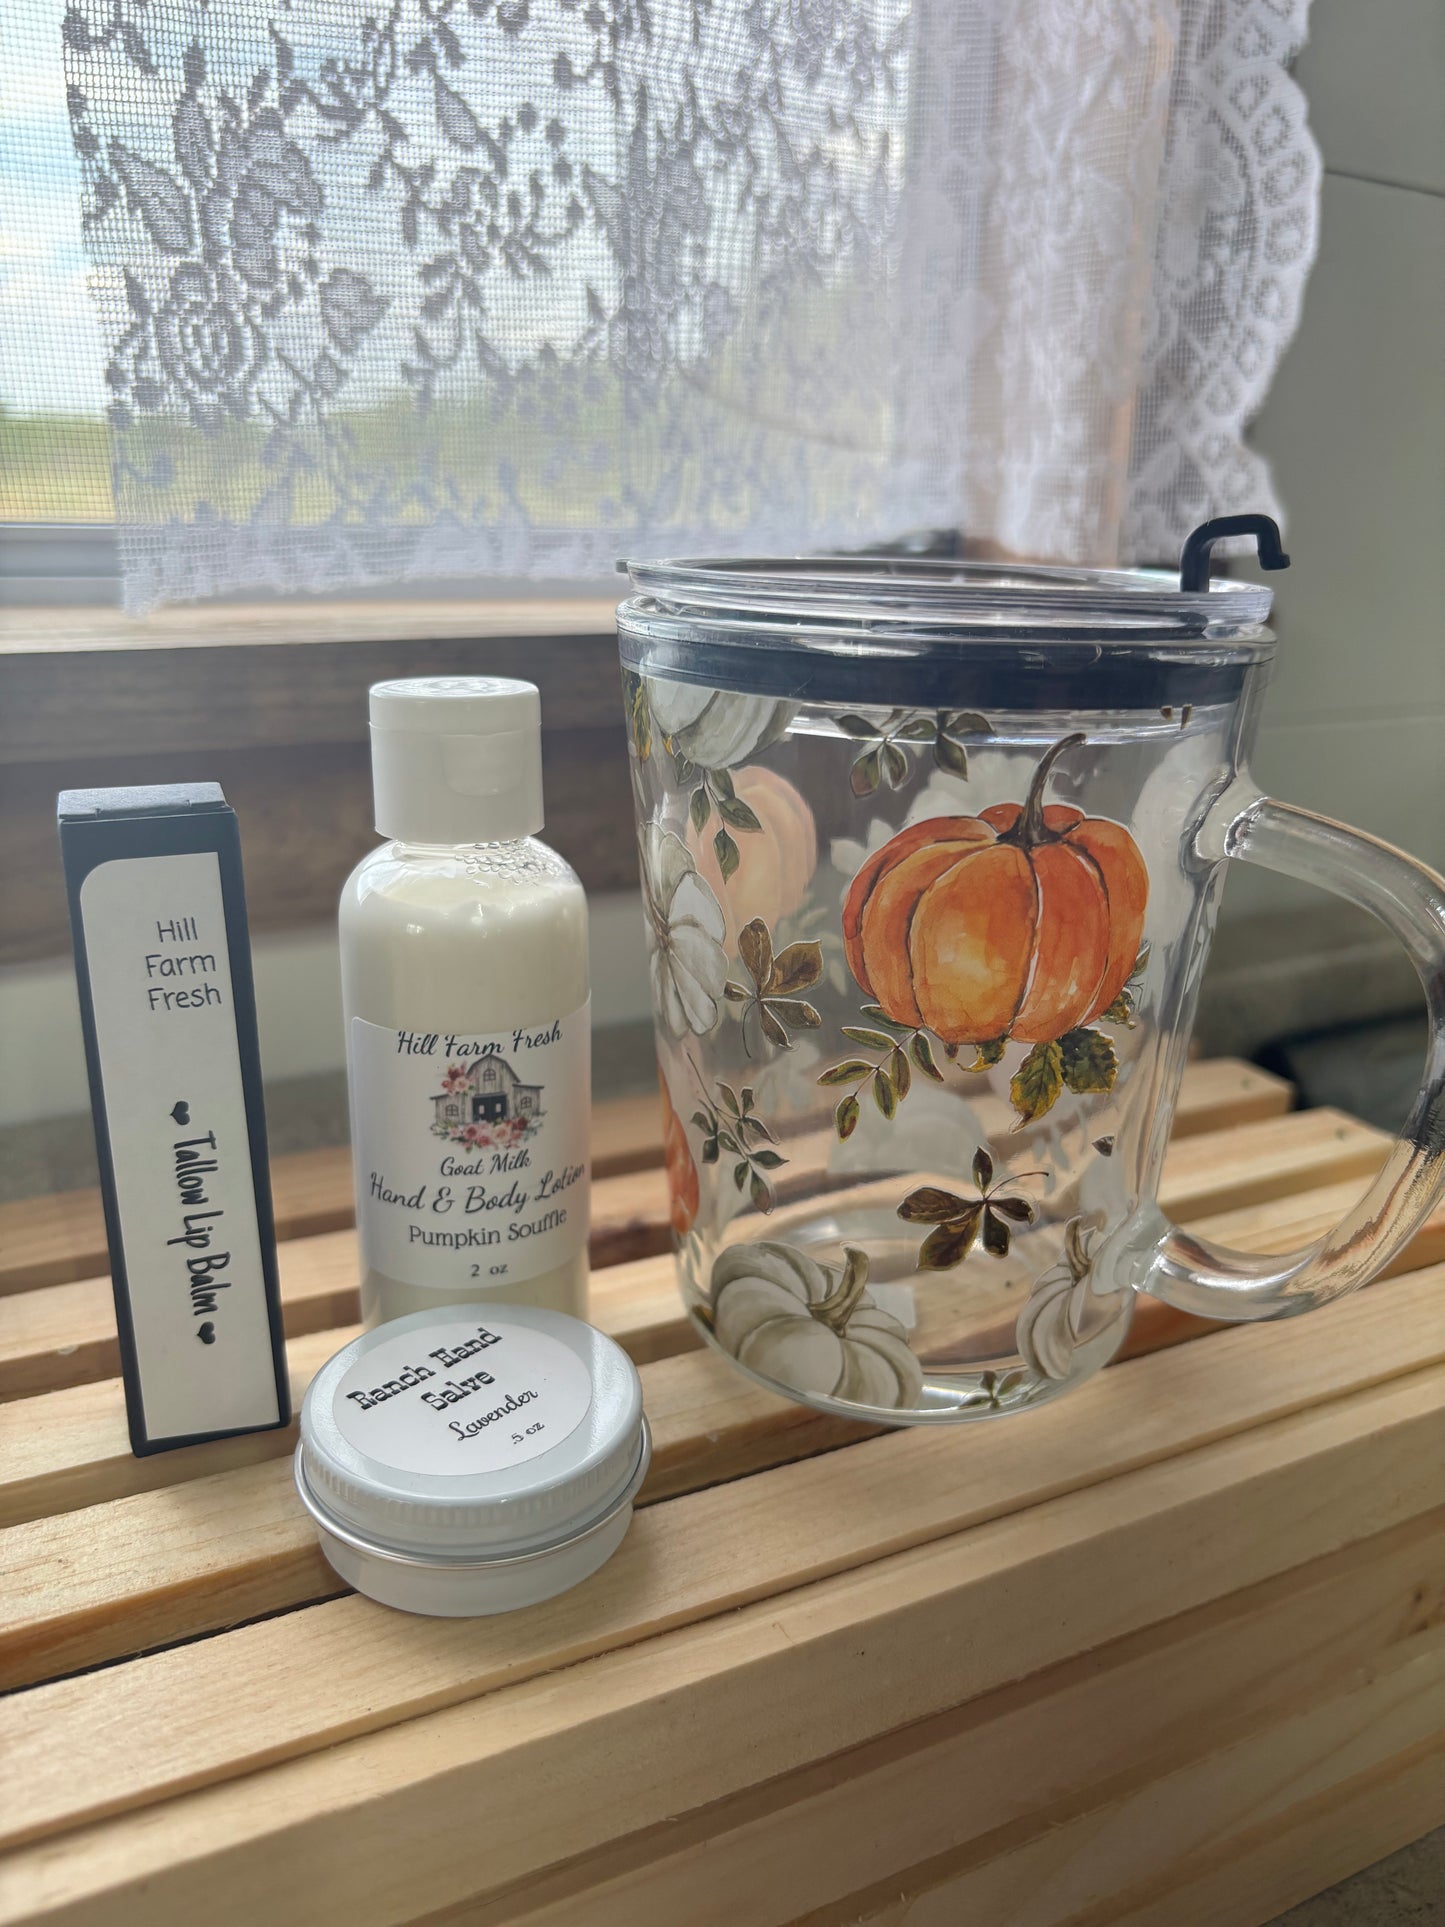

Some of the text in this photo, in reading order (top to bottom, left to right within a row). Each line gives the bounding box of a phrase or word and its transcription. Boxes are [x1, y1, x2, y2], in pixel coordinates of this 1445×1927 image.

[156, 917, 199, 942] Hill
[145, 954, 217, 978] Farm
[147, 983, 222, 1011] Fresh
[397, 1019, 563, 1058] Hill Farm Fresh
[440, 1148, 532, 1177] Goat Milk
[370, 1163, 586, 1214] Hand & Body Lotion
[166, 1130, 232, 1317] Tallow Lip Balm
[408, 1224, 501, 1250] Pumpkin
[470, 1263, 509, 1277] 2 oz
[345, 1327, 503, 1411] Ranch Hand
[420, 1368, 496, 1412] Salve
[448, 1387, 539, 1442] Lavender
[525, 1421, 545, 1436] oz
